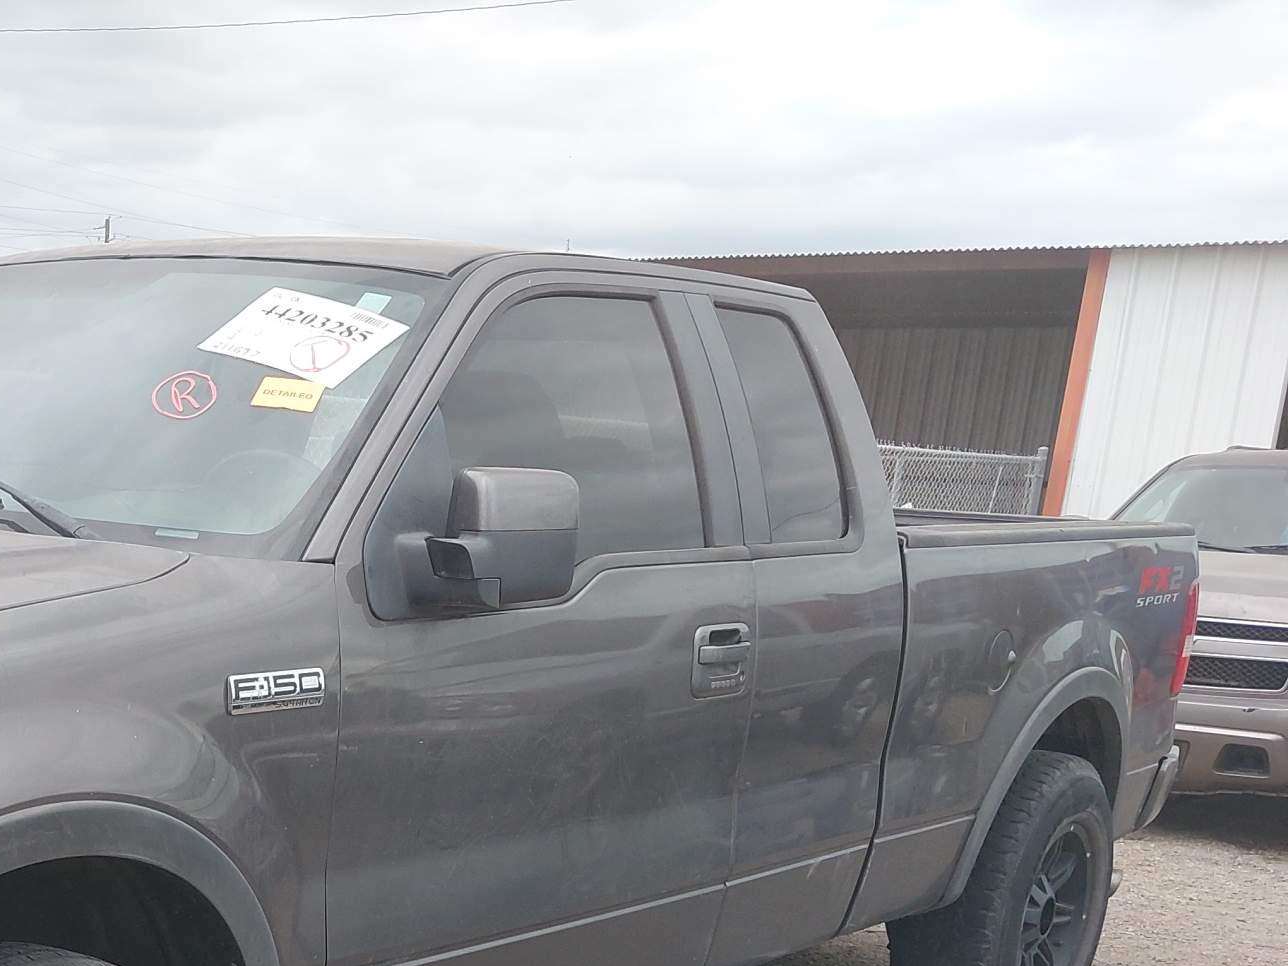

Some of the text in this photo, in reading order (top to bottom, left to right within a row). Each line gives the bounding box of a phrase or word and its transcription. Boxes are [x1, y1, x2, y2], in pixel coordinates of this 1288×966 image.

[261, 304, 374, 344] 44203285
[170, 376, 201, 413] R
[262, 388, 314, 400] DETAILED
[1138, 565, 1185, 594] FX2
[1135, 592, 1181, 608] SPORT
